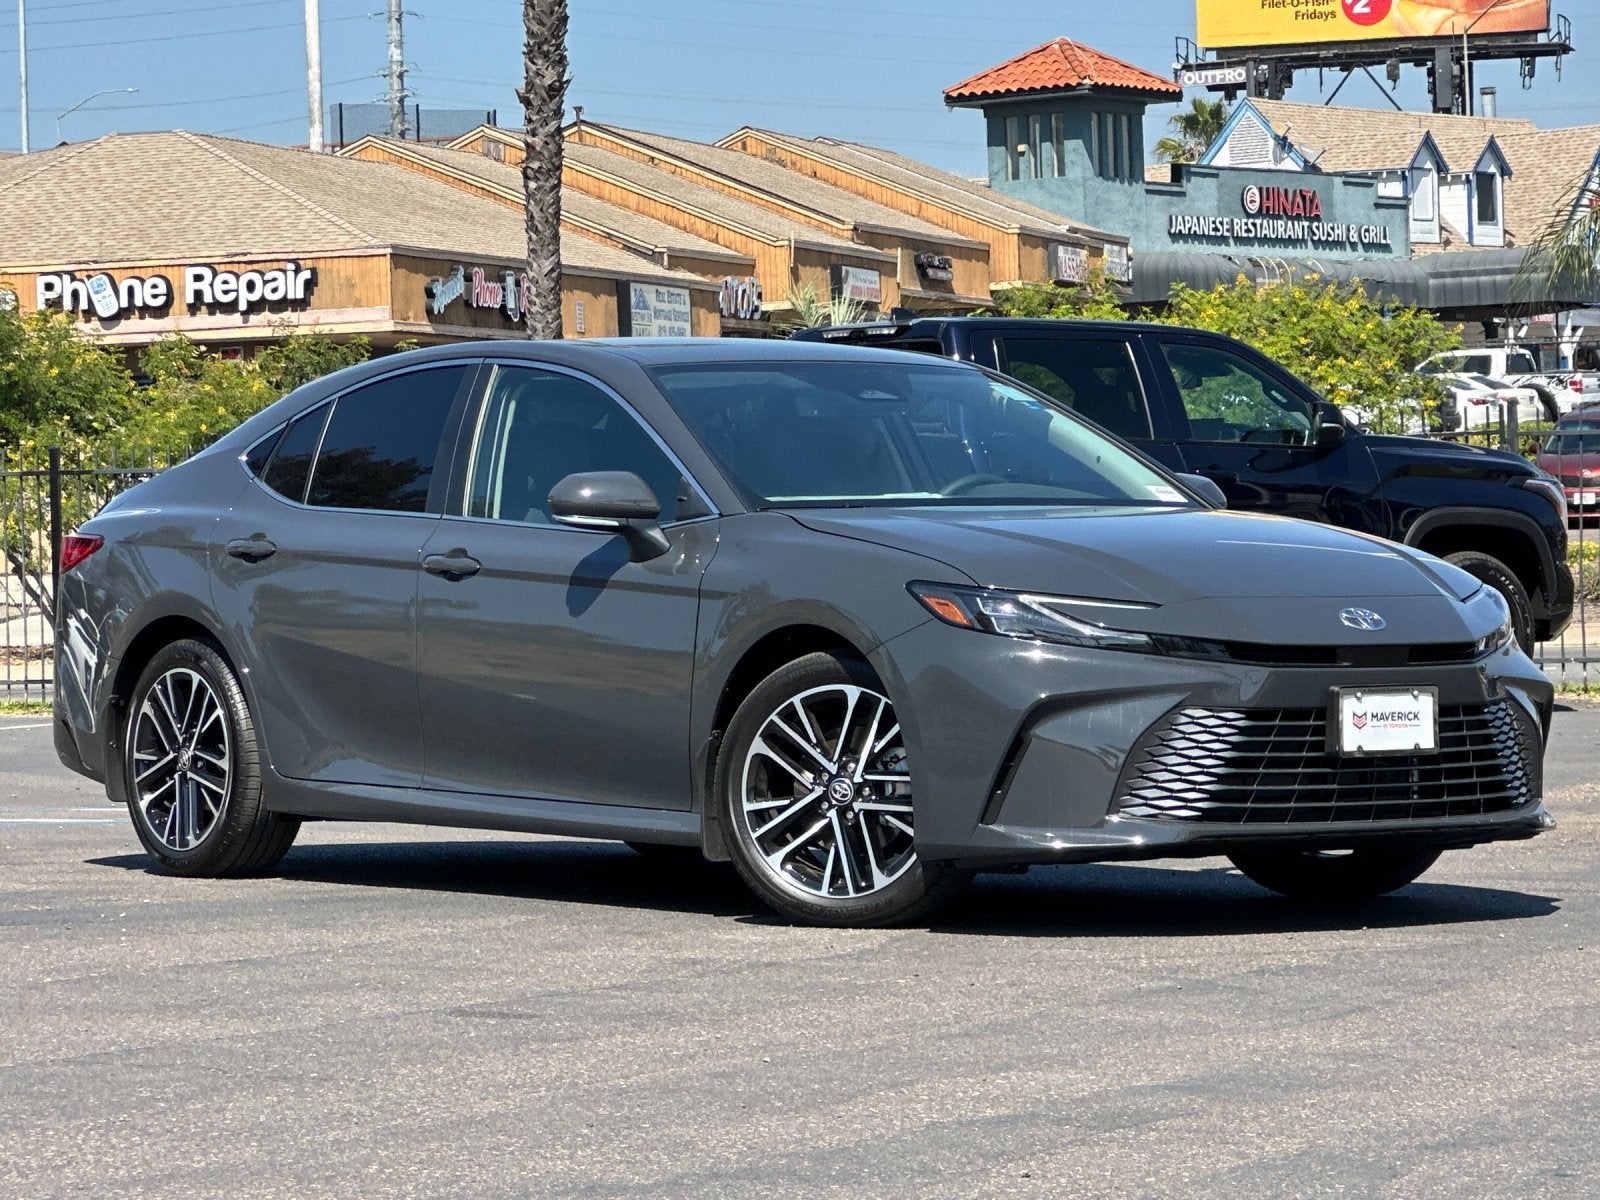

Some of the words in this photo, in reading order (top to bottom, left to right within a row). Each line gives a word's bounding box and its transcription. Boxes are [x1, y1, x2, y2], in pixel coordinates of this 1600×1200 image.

[1294, 9, 1337, 22] Fridays
[1261, 187, 1322, 217] HINATA
[1170, 215, 1230, 237] JAPANESE
[1234, 219, 1309, 241] RESTAURANT
[1313, 223, 1346, 241] SUSHI
[1349, 225, 1358, 243] &
[1361, 226, 1391, 244] GRILL
[184, 262, 313, 313] Repair
[472, 267, 502, 308] Phone
[1370, 711, 1420, 722] MAVERICK
